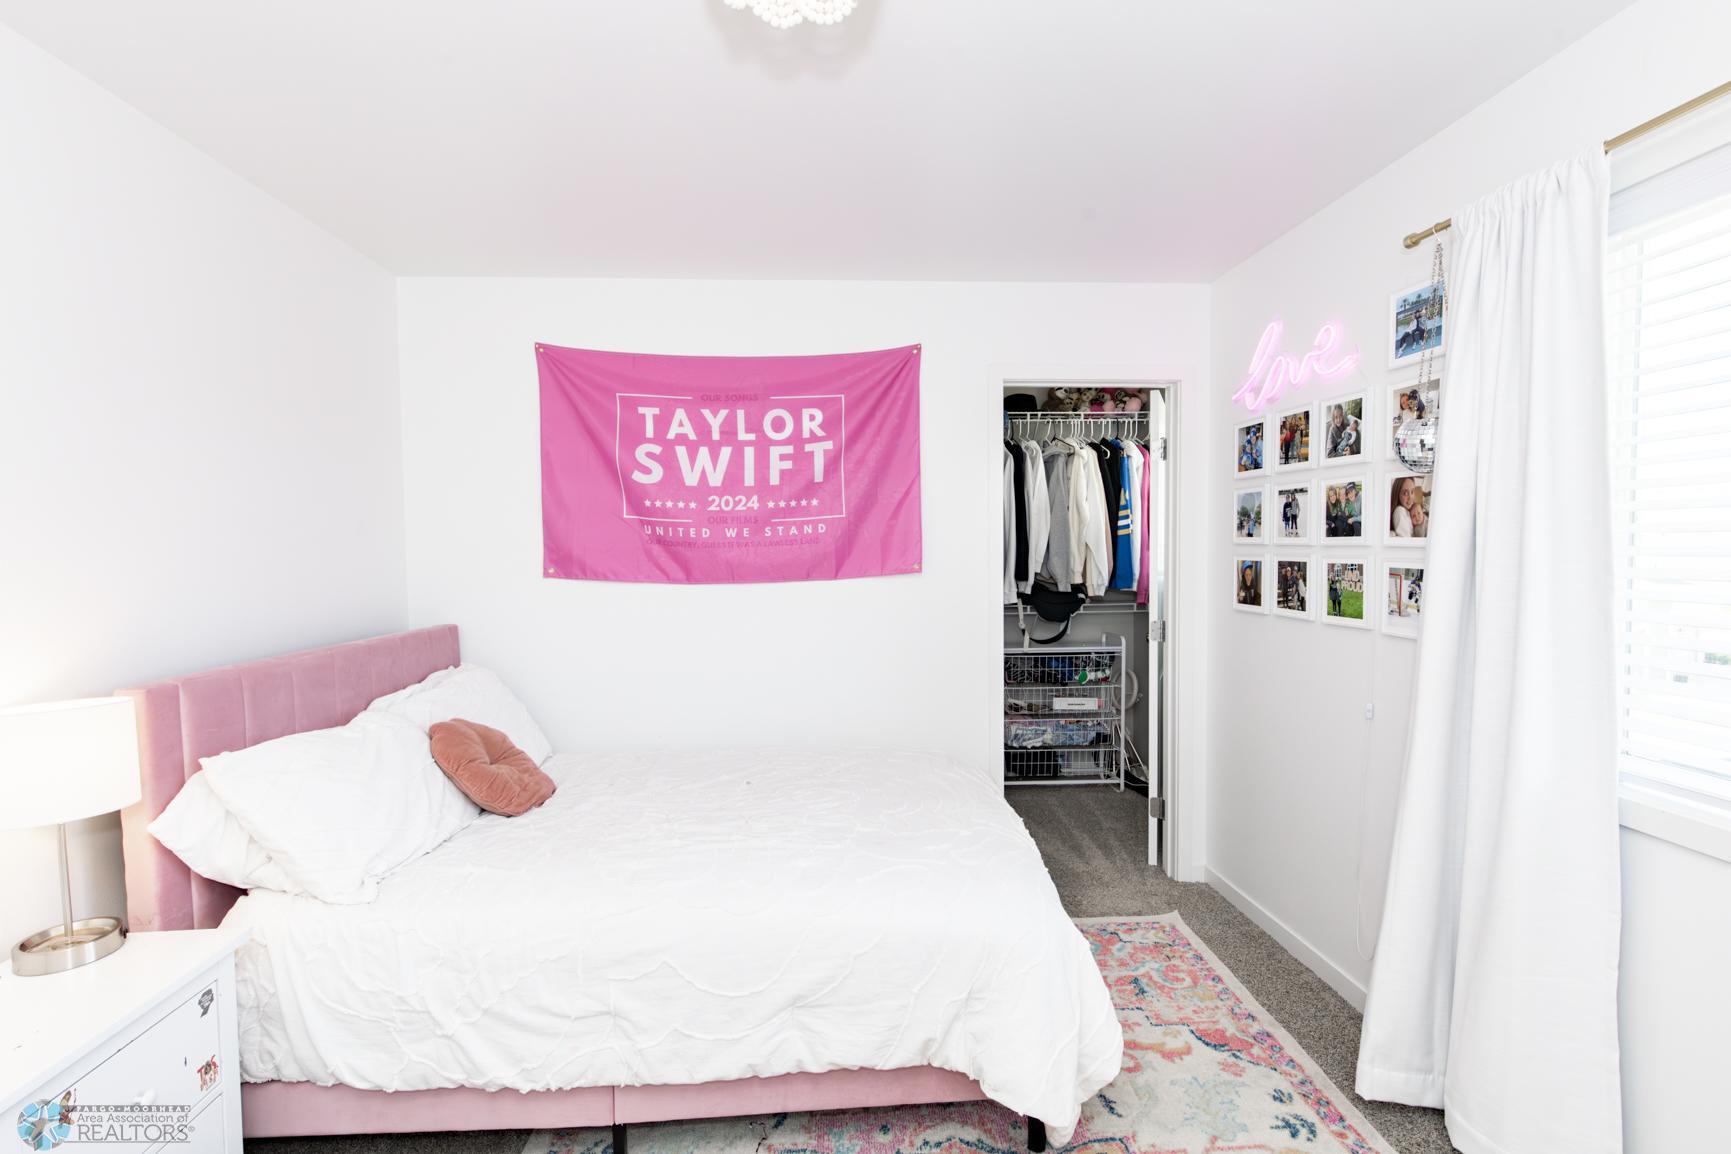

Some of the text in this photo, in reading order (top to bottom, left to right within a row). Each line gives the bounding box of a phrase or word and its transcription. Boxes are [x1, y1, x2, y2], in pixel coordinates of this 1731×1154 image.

[1231, 321, 1359, 411] love
[637, 406, 827, 441] TAYLOR
[631, 440, 834, 487] SWIFT
[706, 495, 760, 511] 2024
[644, 523, 827, 538] UNITED WE STAND
